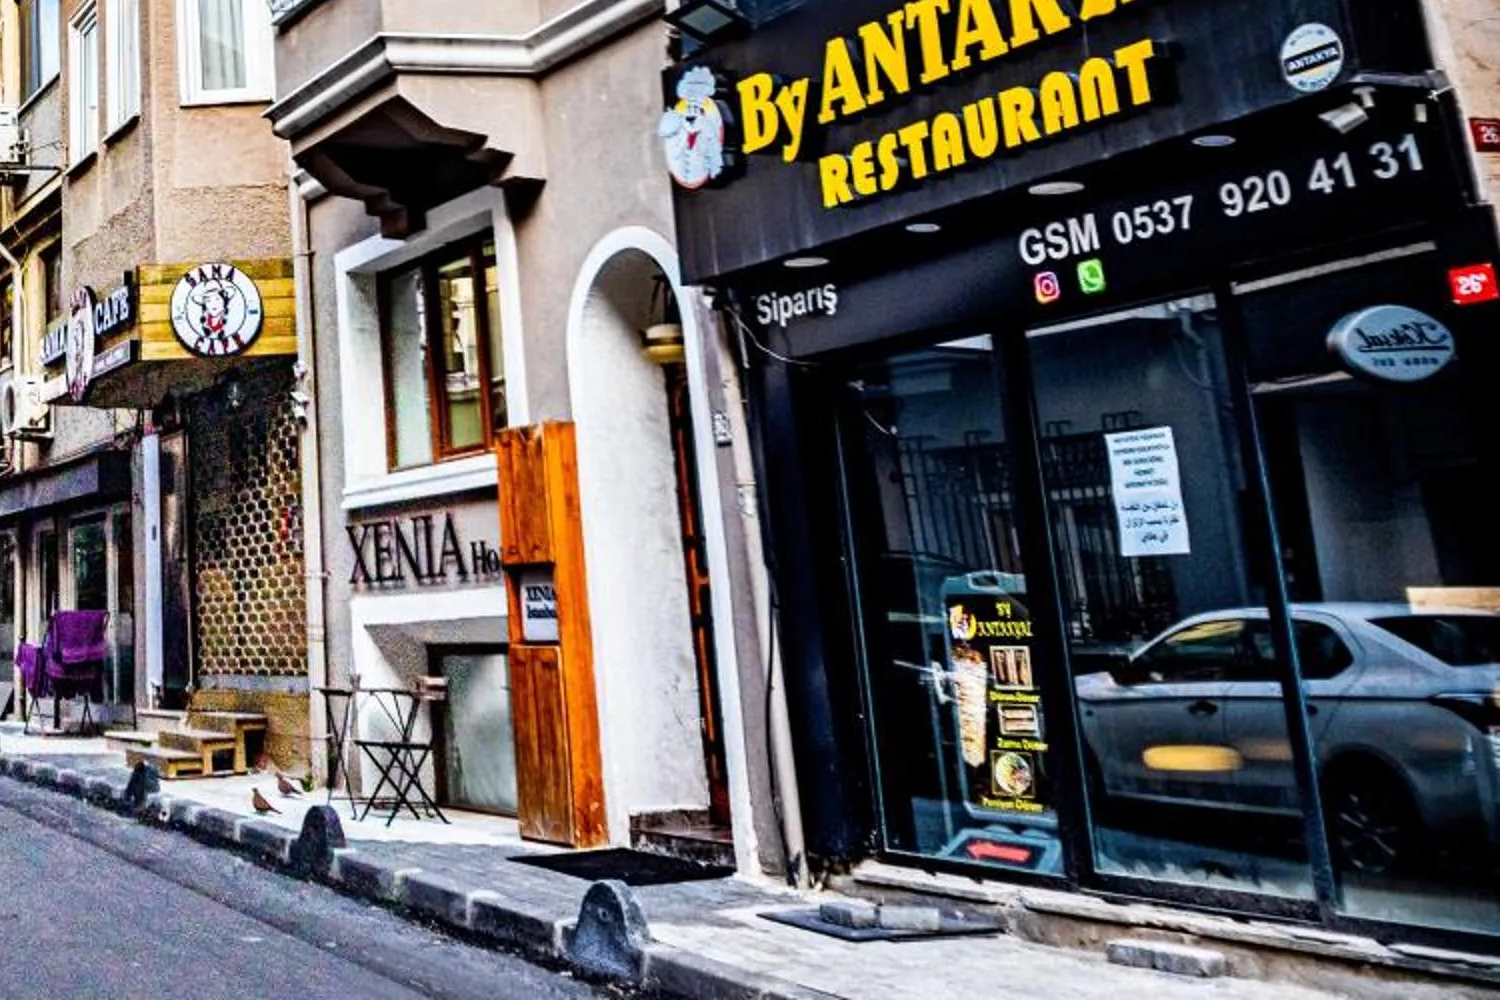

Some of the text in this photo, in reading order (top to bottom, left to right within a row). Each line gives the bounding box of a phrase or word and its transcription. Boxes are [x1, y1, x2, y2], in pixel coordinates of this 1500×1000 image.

[736, 72, 809, 164] By
[1018, 133, 1424, 266] GSM 0537 920 41 31
[95, 284, 130, 335] CAFE
[345, 512, 468, 585] XENIA
